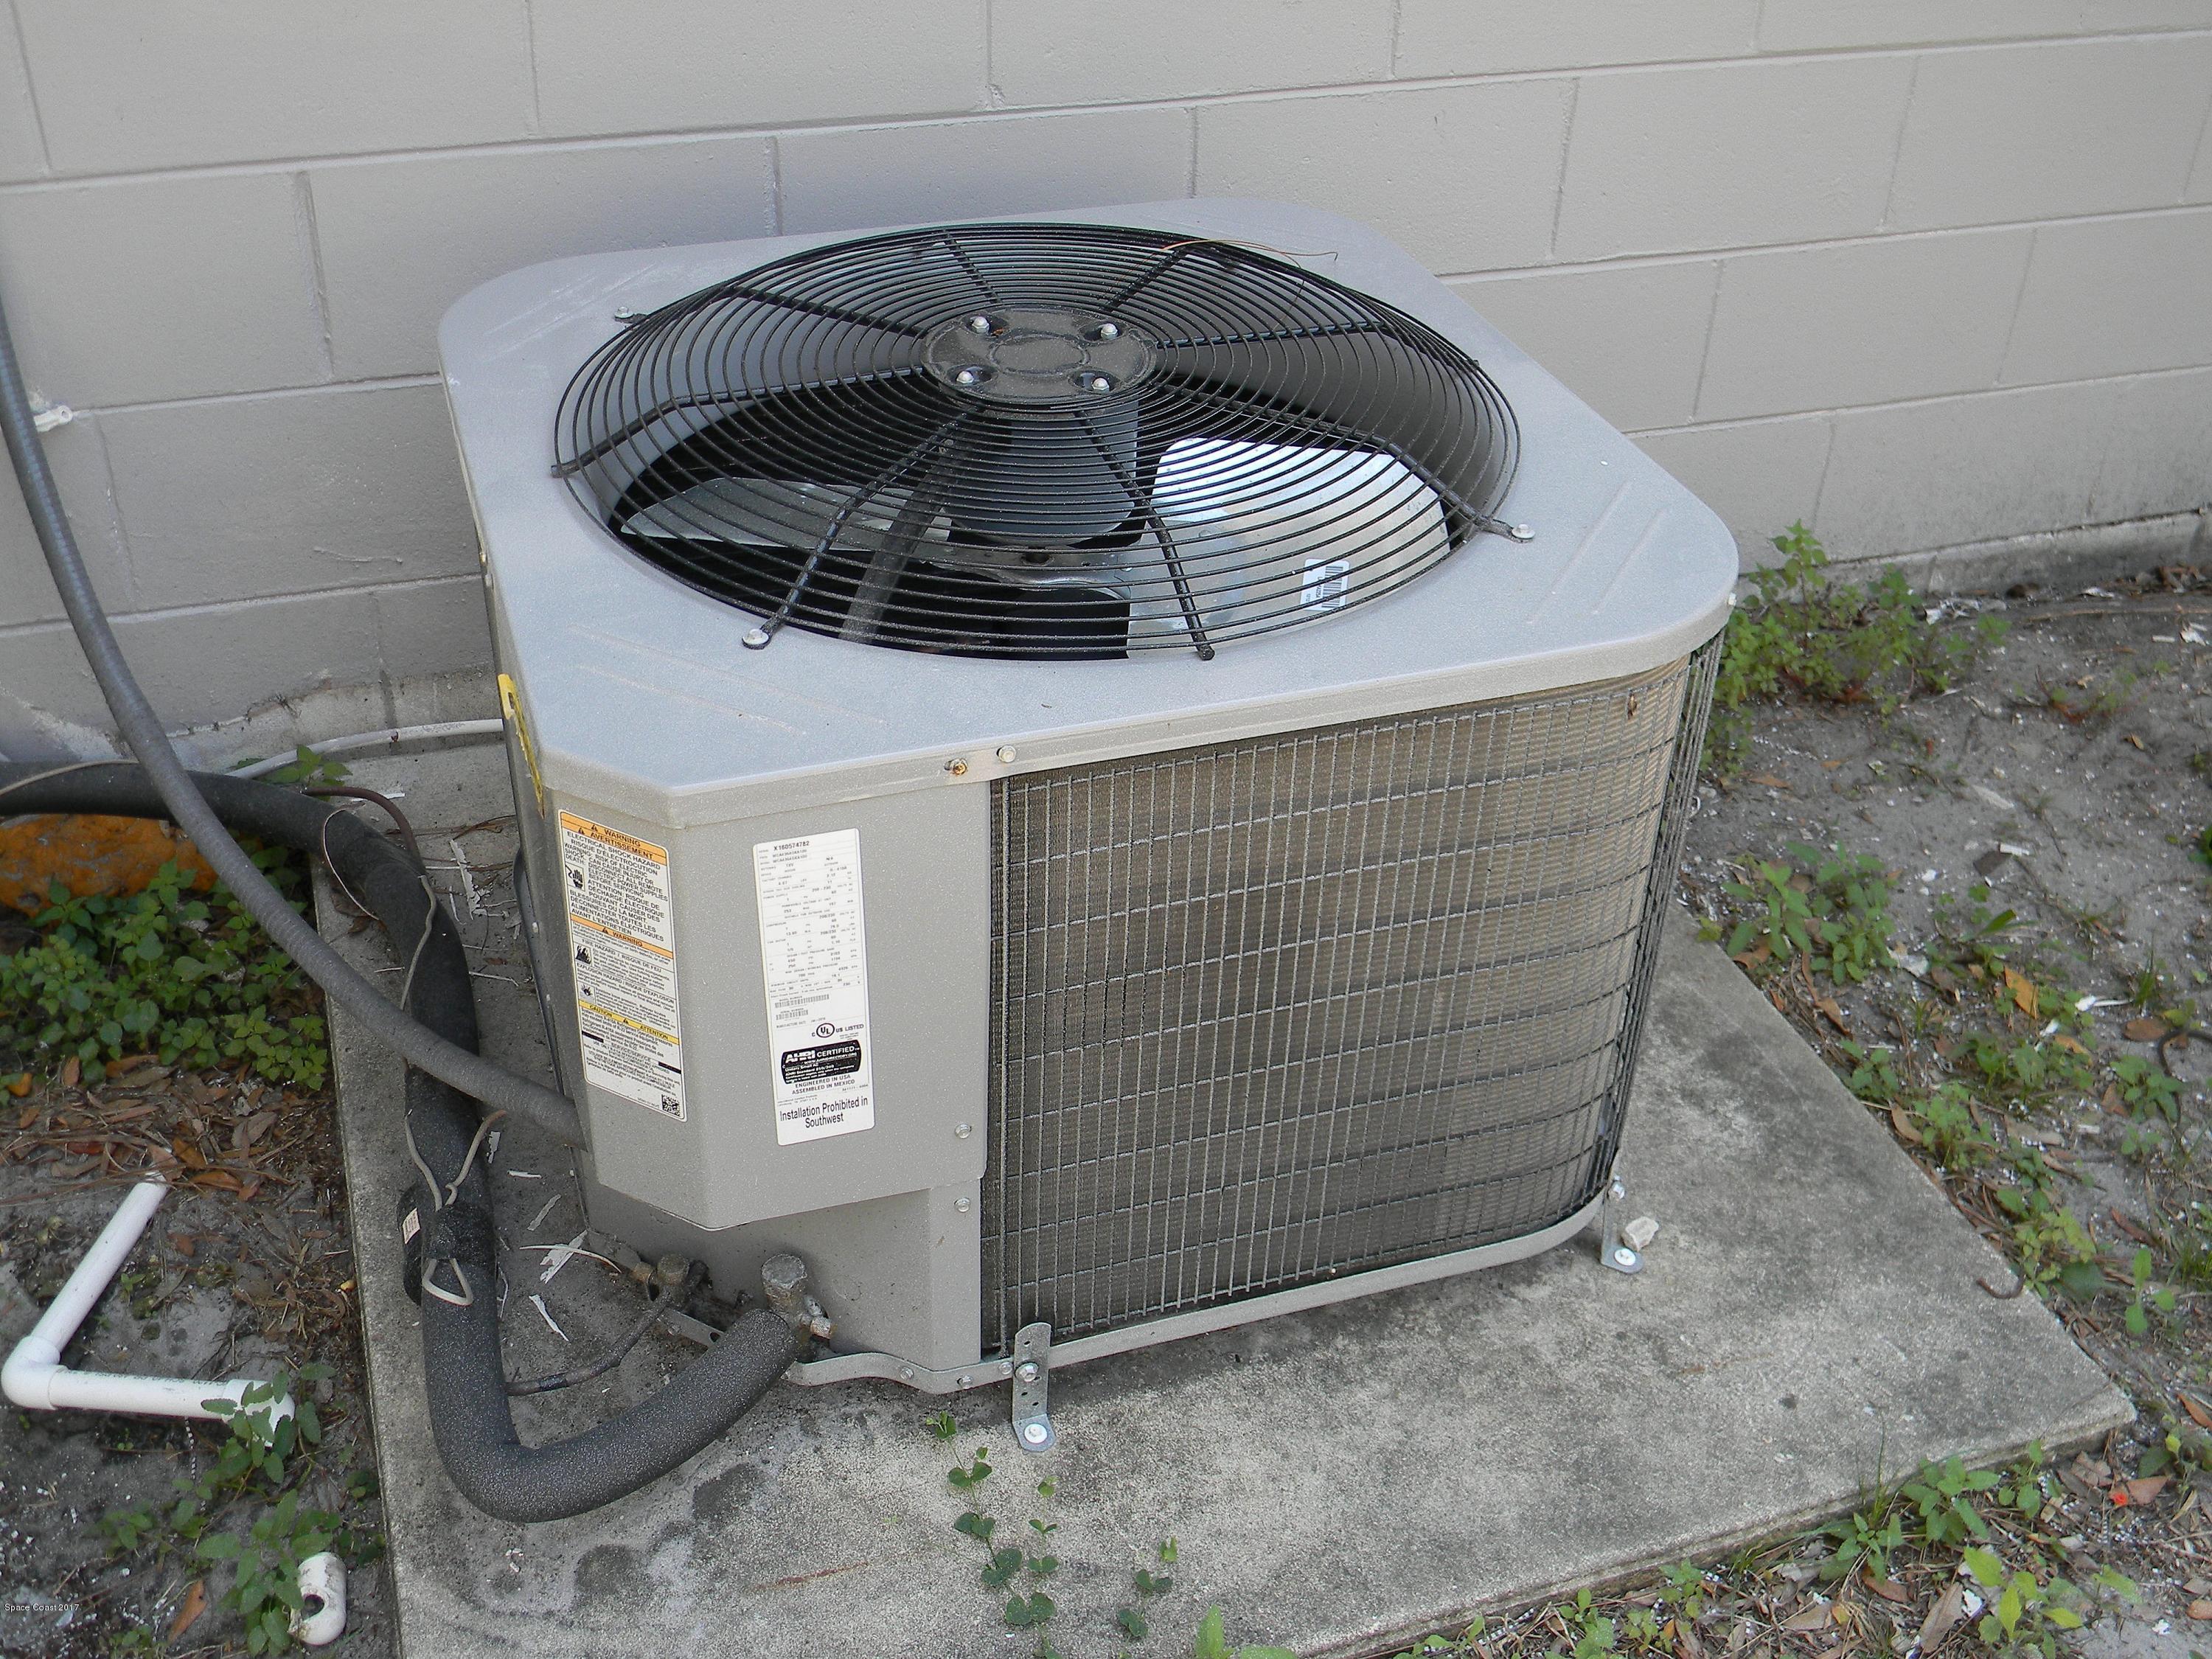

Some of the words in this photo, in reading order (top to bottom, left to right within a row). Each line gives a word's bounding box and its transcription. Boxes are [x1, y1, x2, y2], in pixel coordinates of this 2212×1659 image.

[571, 839, 595, 852] RISQUE
[591, 832, 653, 860] AVERTISSEMENT
[605, 830, 641, 847] WARNING
[774, 841, 810, 852] X160574782
[568, 832, 605, 850] ELECTRICAL
[608, 846, 632, 860] SHOCK
[633, 856, 661, 870] HAZARD
[588, 857, 602, 866] CAN
[602, 863, 622, 874] CAUSE
[624, 871, 644, 882] INJURY
[596, 855, 608, 863] RISK
[619, 863, 647, 878] ELECTRIC
[588, 863, 625, 880] DISCONNECT
[627, 877, 637, 885] ALL
[639, 881, 662, 894] REMOTE
[588, 868, 616, 883] ELECTRIC
[618, 879, 639, 891] POWER
[640, 887, 668, 902] SUPPLIES
[589, 874, 612, 886] BEFORE
[570, 890, 606, 908] BLESSURES
[589, 891, 618, 907] POUVANT
[619, 903, 645, 917] CAUSER
[647, 914, 660, 922] DES
[626, 894, 650, 907] RISQUE
[571, 902, 619, 925] ALIMENTATIONS
[571, 908, 591, 919] AVANT
[618, 914, 642, 928] TOUTES
[644, 925, 656, 933] LES
[613, 931, 643, 947] WARNING
[595, 944, 615, 955] HAZARD
[622, 954, 641, 965] RISQUE
[577, 964, 602, 976] EXPLOSION
[603, 973, 622, 984] HAZARD
[626, 982, 642, 992] RISQUE
[590, 1006, 612, 1018] CAUTION
[640, 1026, 668, 1040] ATTENTION
[785, 1050, 816, 1063] AHRI
[817, 1046, 855, 1057] CERTIFIED
[793, 1085, 824, 1095] ASSEMBLED
[835, 1079, 855, 1088] MEXICO
[796, 1078, 830, 1088] ENGINEERED
[780, 1104, 820, 1121] Installation
[822, 1096, 859, 1113] Prohibited
[861, 1095, 868, 1105] in
[805, 1112, 844, 1128] Southwest
